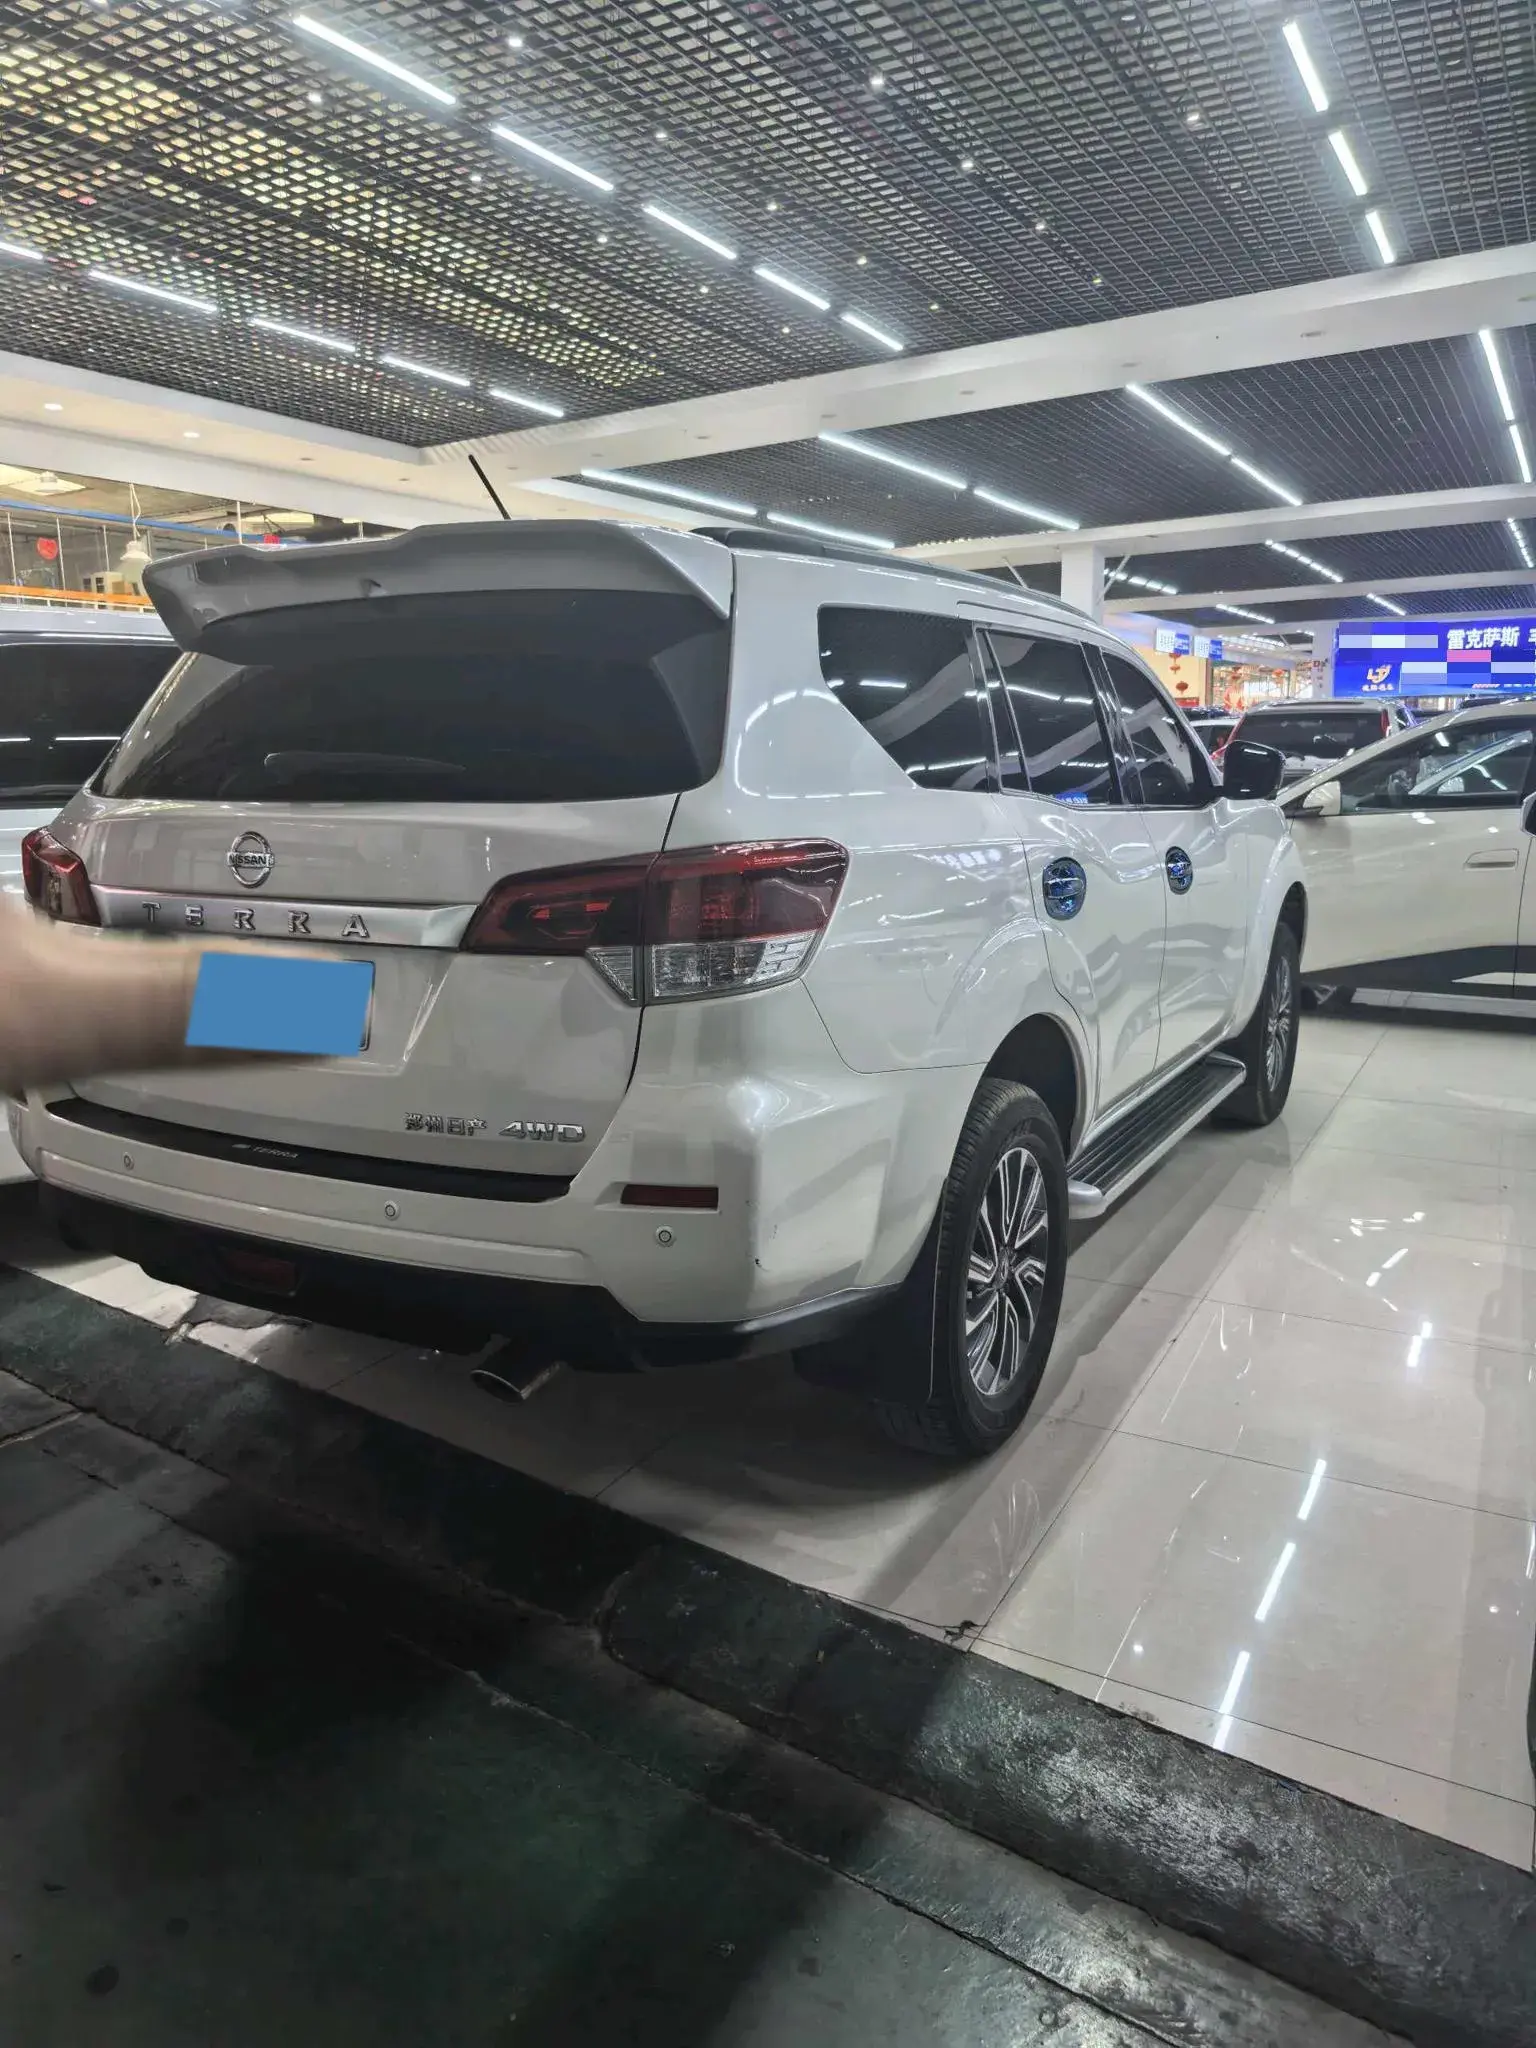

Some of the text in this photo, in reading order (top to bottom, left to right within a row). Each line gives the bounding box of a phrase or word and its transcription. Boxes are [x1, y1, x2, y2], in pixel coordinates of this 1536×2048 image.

[1447, 626, 1520, 650] 雷克萨斯
[229, 855, 267, 865] NISSAN
[142, 901, 370, 938] TERRA
[405, 1112, 586, 1143] 郑州日产 4WD
